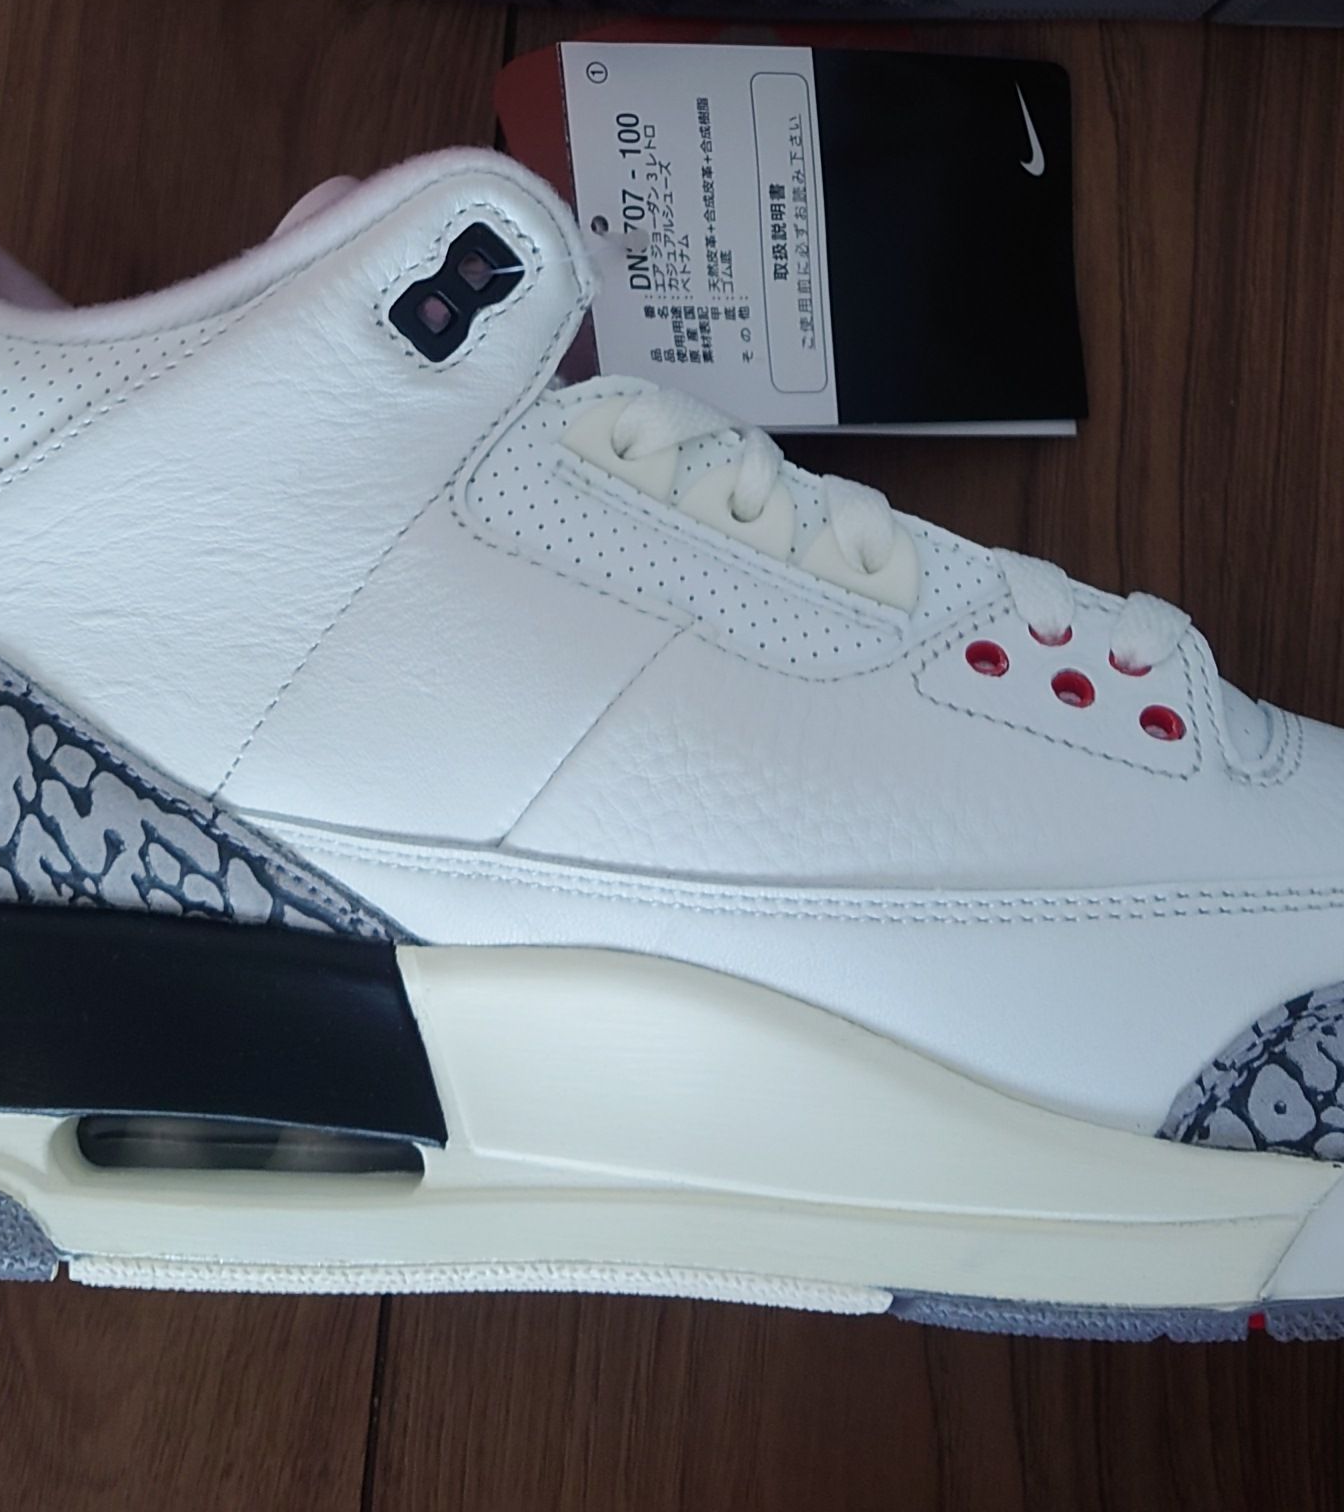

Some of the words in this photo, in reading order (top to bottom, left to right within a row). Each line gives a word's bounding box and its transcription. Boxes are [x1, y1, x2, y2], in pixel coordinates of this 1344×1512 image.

[616, 113, 641, 159] 100
[622, 189, 651, 290] DN707
[769, 183, 789, 281] 取扱説明書
